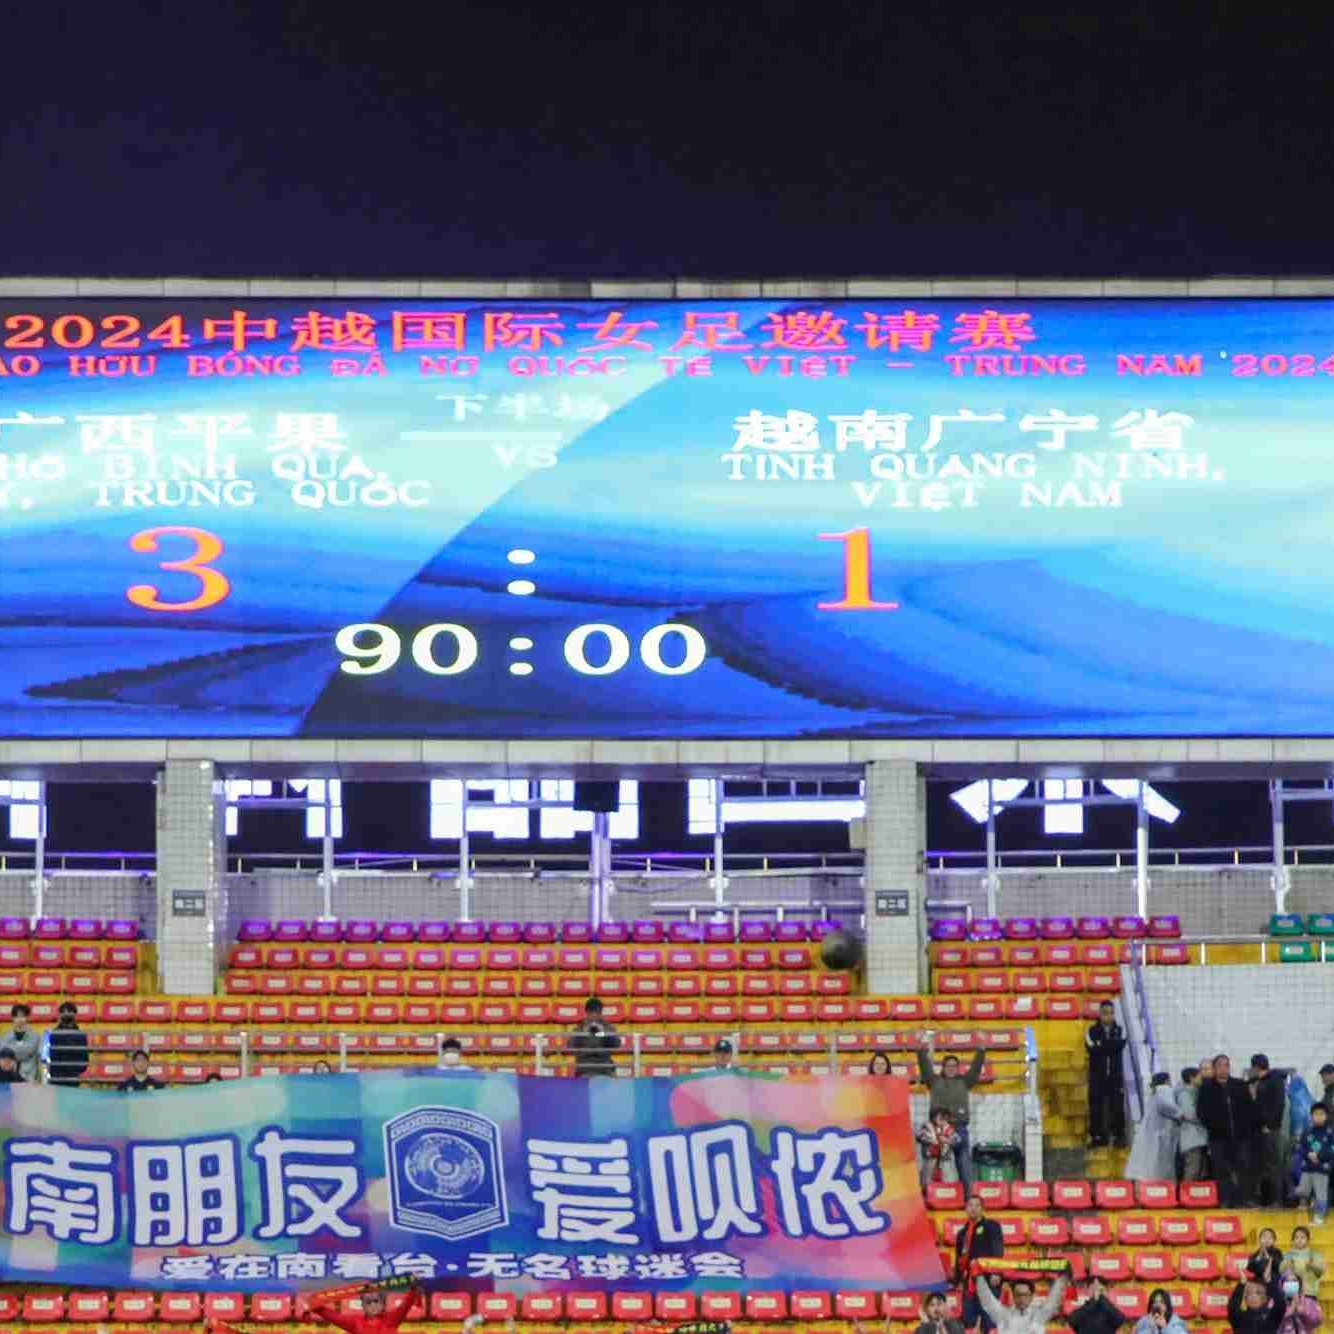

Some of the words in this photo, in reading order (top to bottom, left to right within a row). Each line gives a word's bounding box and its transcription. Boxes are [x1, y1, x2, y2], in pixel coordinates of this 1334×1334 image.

[3, 309, 1037, 353] 2024中越国际女足邀请赛
[186, 350, 301, 377] BÓNG
[944, 353, 1088, 377] TRUNG
[731, 408, 1196, 453] 越南广宁省
[489, 441, 560, 469] VS
[88, 478, 256, 508] TRUNG
[1021, 481, 1124, 509] NAM
[126, 525, 231, 612] 3
[816, 525, 900, 612] 1
[6, 1130, 362, 1246] 南朋友
[525, 1124, 886, 1246] 爱呗侬
